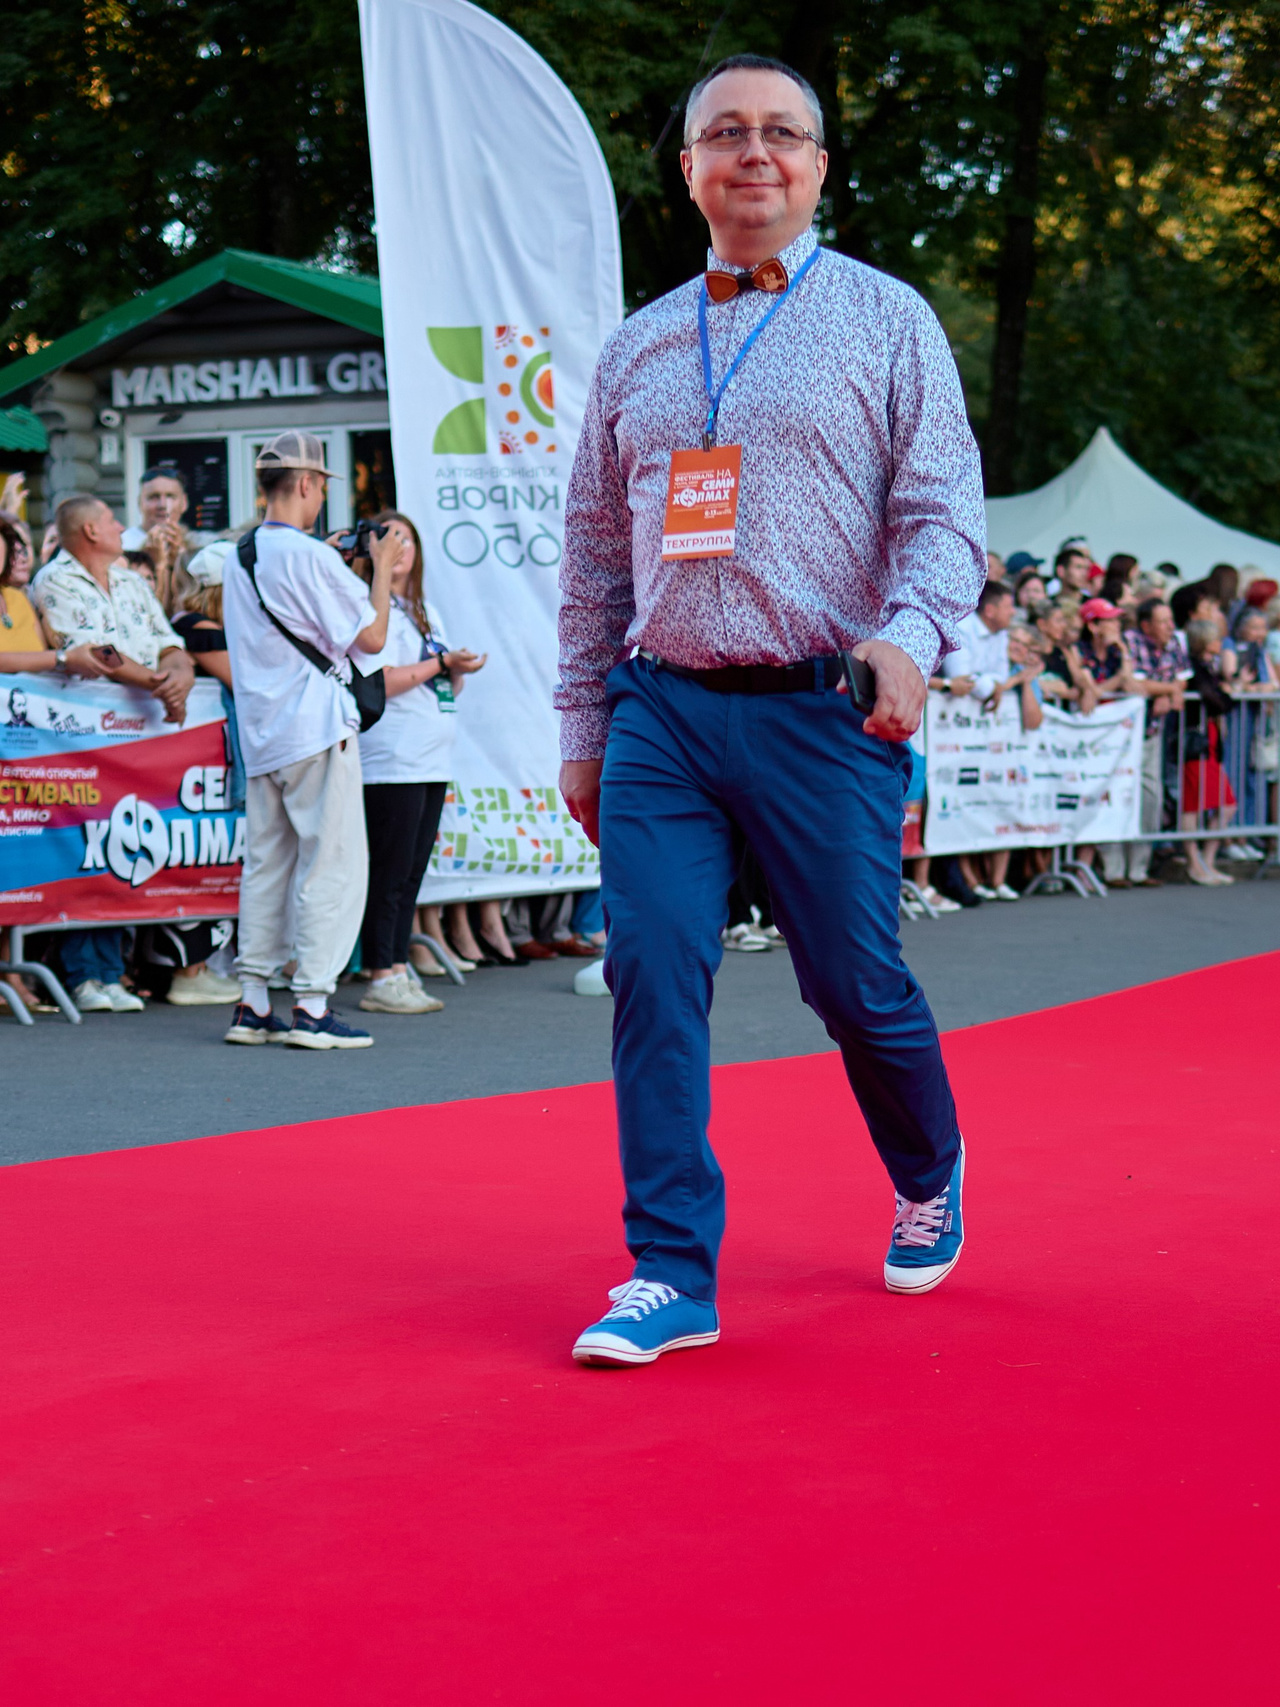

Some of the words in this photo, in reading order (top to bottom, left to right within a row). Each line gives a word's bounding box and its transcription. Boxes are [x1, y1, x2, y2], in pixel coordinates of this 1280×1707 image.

[111, 356, 321, 407] MARSHALL
[717, 468, 731, 479] НА
[702, 477, 734, 490] СЕМИ
[666, 535, 732, 549] ТЕХГРУППА
[12, 808, 51, 823] КИНО
